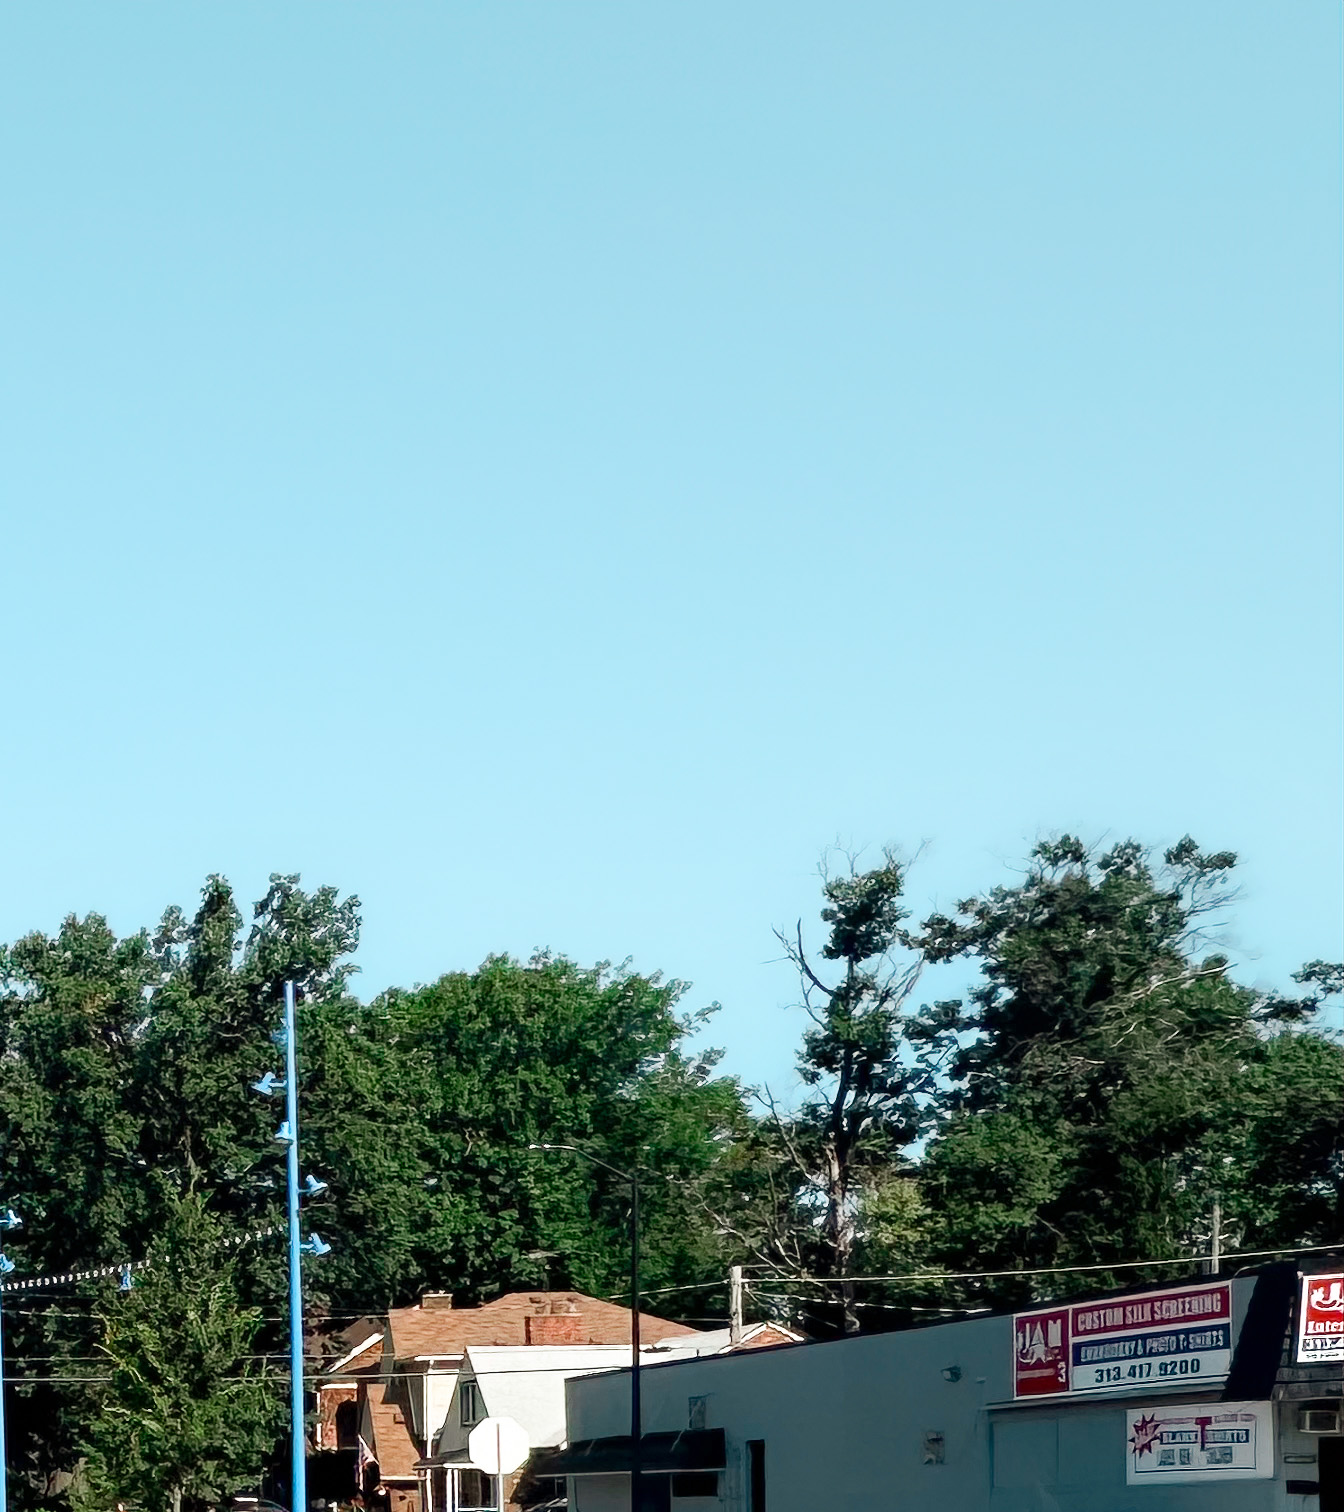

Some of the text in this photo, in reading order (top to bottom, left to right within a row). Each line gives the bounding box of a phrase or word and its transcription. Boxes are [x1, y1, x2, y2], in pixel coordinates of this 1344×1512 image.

[1078, 1293, 1222, 1332] CUSTOM SILK SCREENING
